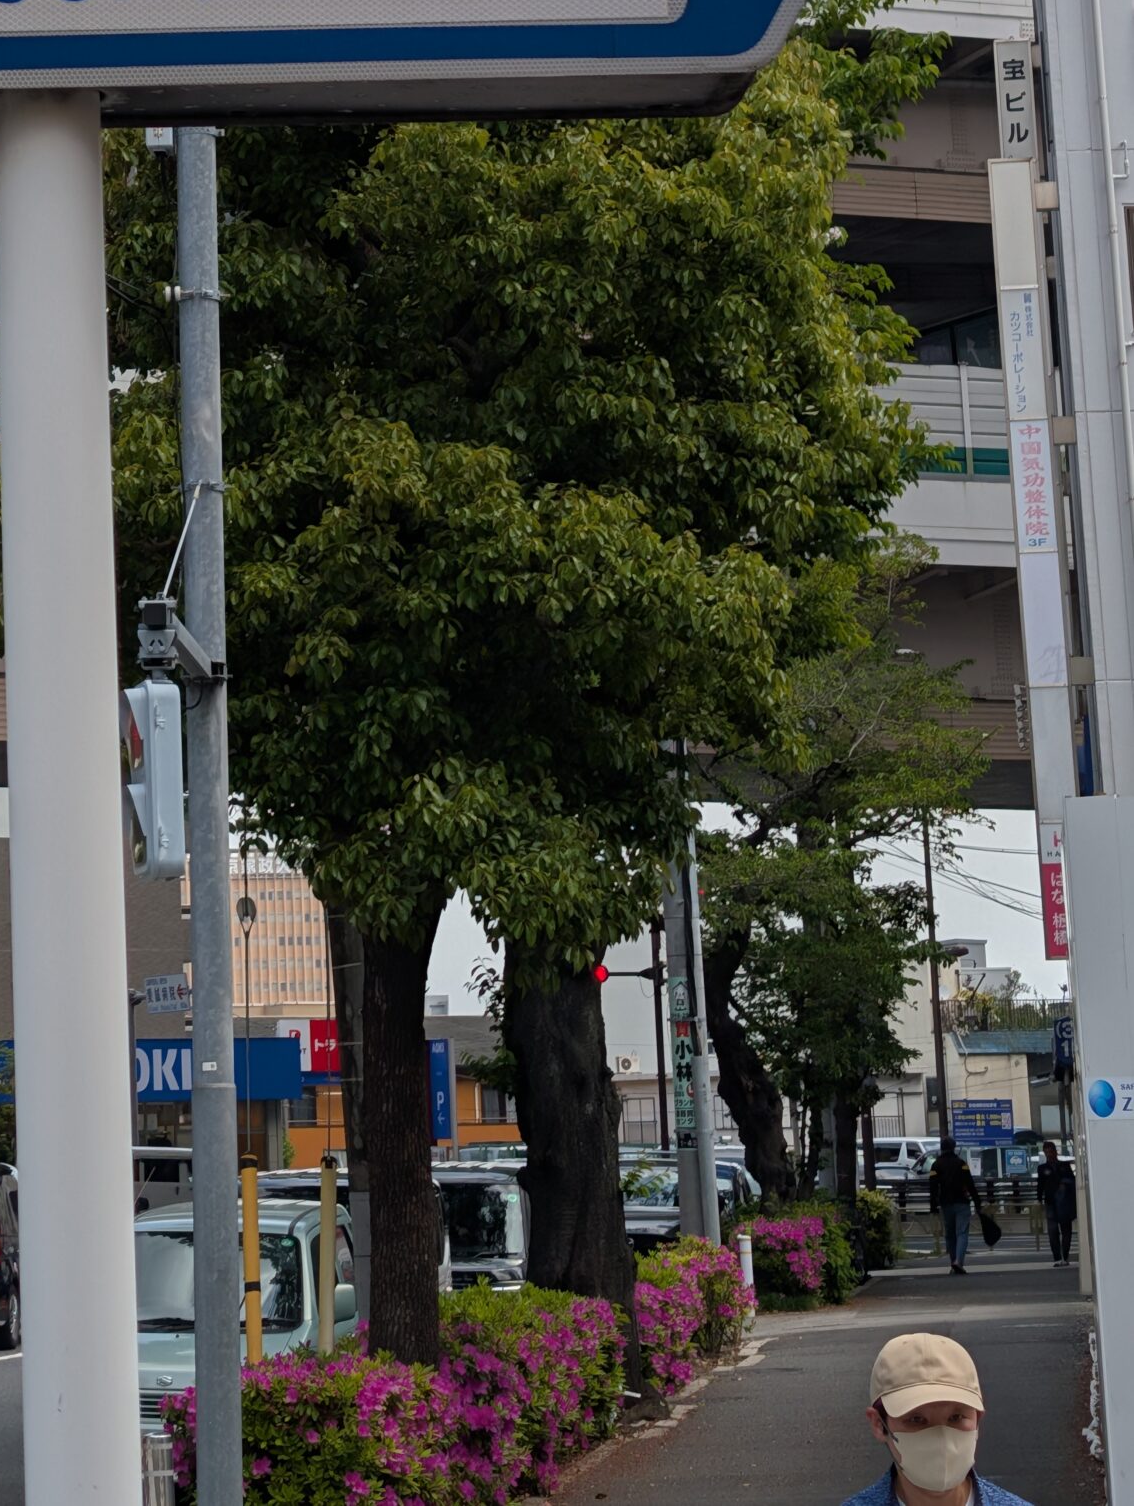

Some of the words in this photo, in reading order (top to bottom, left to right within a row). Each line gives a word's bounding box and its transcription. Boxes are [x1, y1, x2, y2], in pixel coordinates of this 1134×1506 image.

[1002, 58, 1029, 144] 宝ビル
[1028, 537, 1047, 547] 3F
[436, 1091, 445, 1110] P
